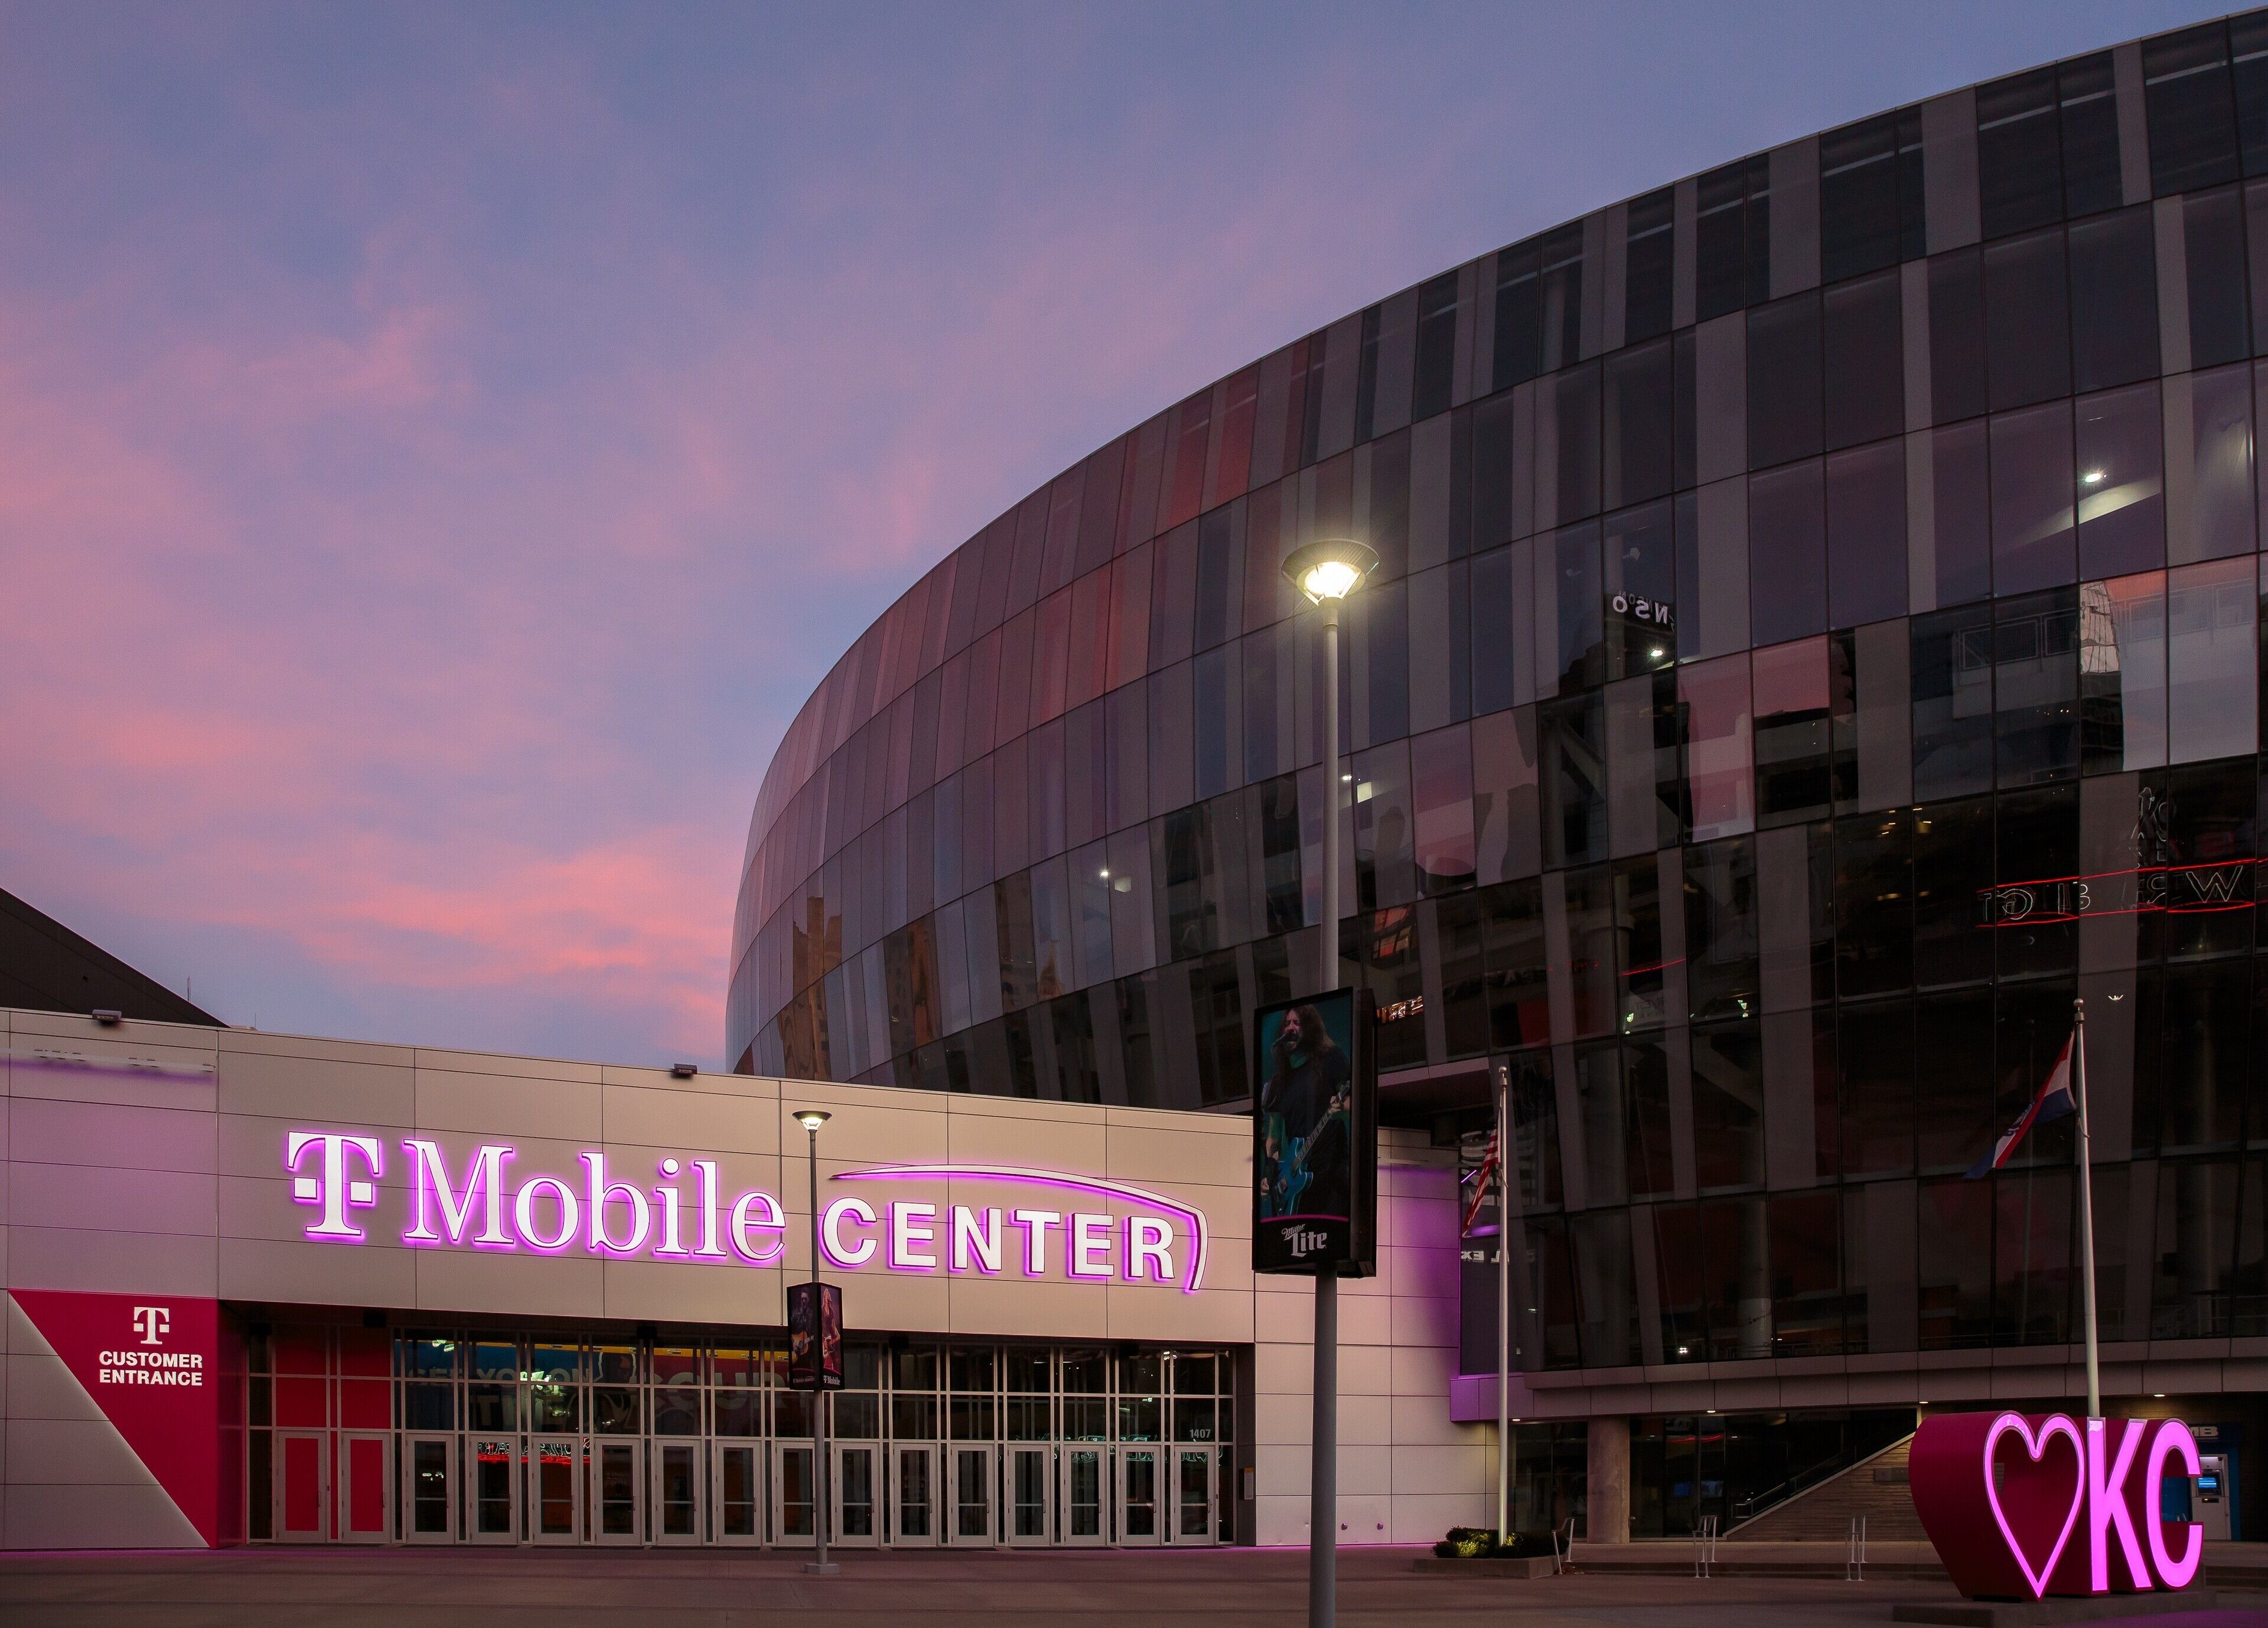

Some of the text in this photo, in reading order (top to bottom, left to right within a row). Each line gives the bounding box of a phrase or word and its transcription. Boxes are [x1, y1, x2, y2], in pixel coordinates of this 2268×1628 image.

[403, 1138, 786, 1261] Mobile
[820, 1197, 1175, 1280] CENTER
[1281, 1224, 1305, 1239] Miller
[1291, 1231, 1327, 1257] Lite
[99, 1351, 203, 1368] CUSTOMER
[99, 1369, 203, 1386] ENTRANCE
[827, 1375, 840, 1385] Mobile
[1189, 1428, 1211, 1438] 1407
[2087, 1417, 2204, 1591] KC
